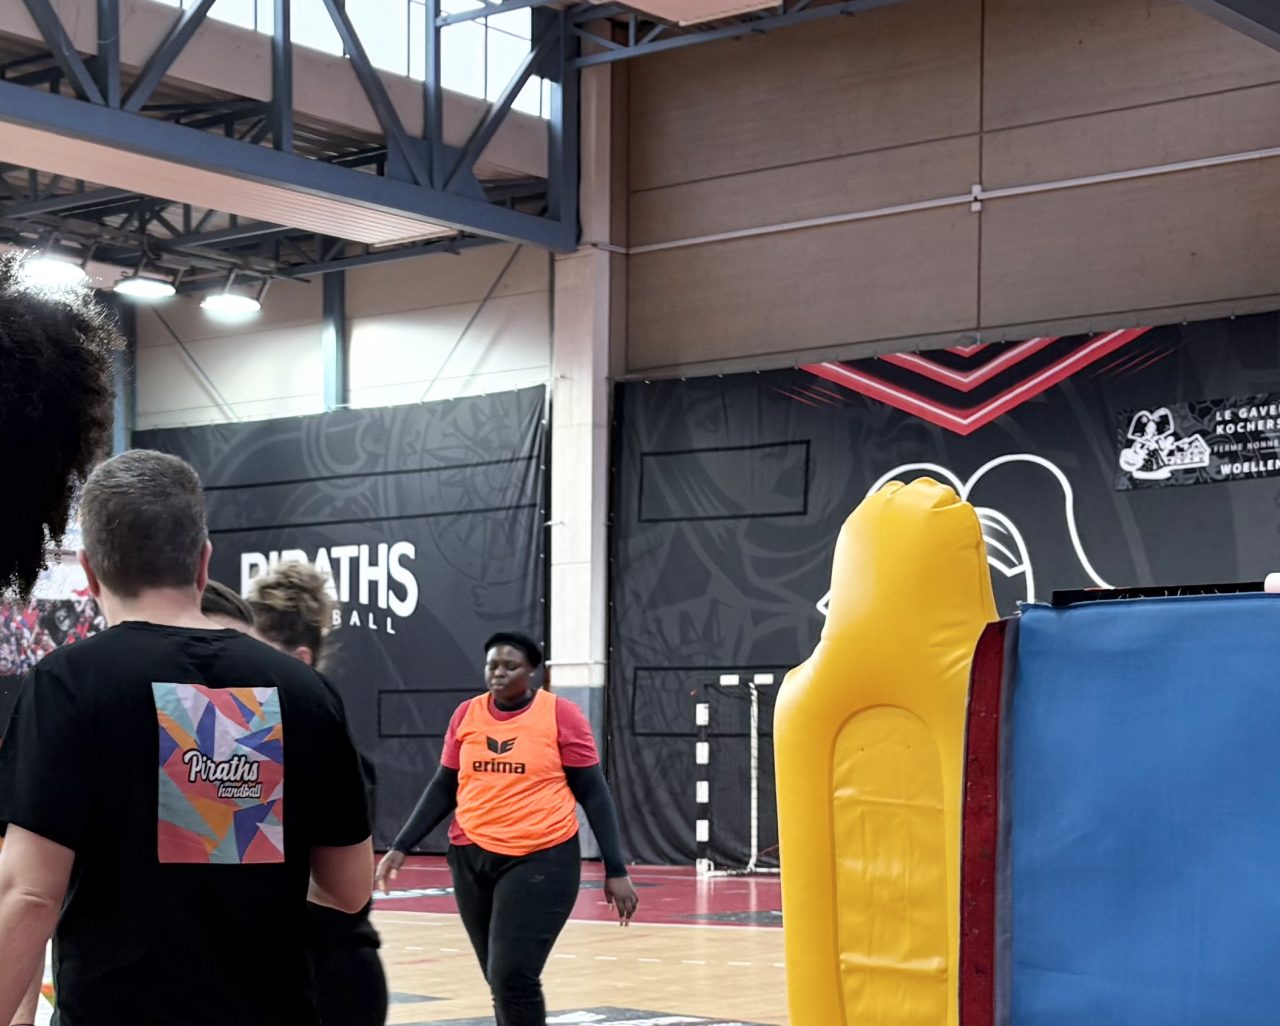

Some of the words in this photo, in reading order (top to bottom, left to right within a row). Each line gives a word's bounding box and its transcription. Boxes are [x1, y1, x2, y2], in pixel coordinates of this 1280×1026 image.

[1215, 409, 1232, 421] LE
[1238, 404, 1280, 419] GAVE
[183, 750, 260, 783] Piraths
[472, 757, 526, 775] erima
[217, 782, 262, 798] handball
